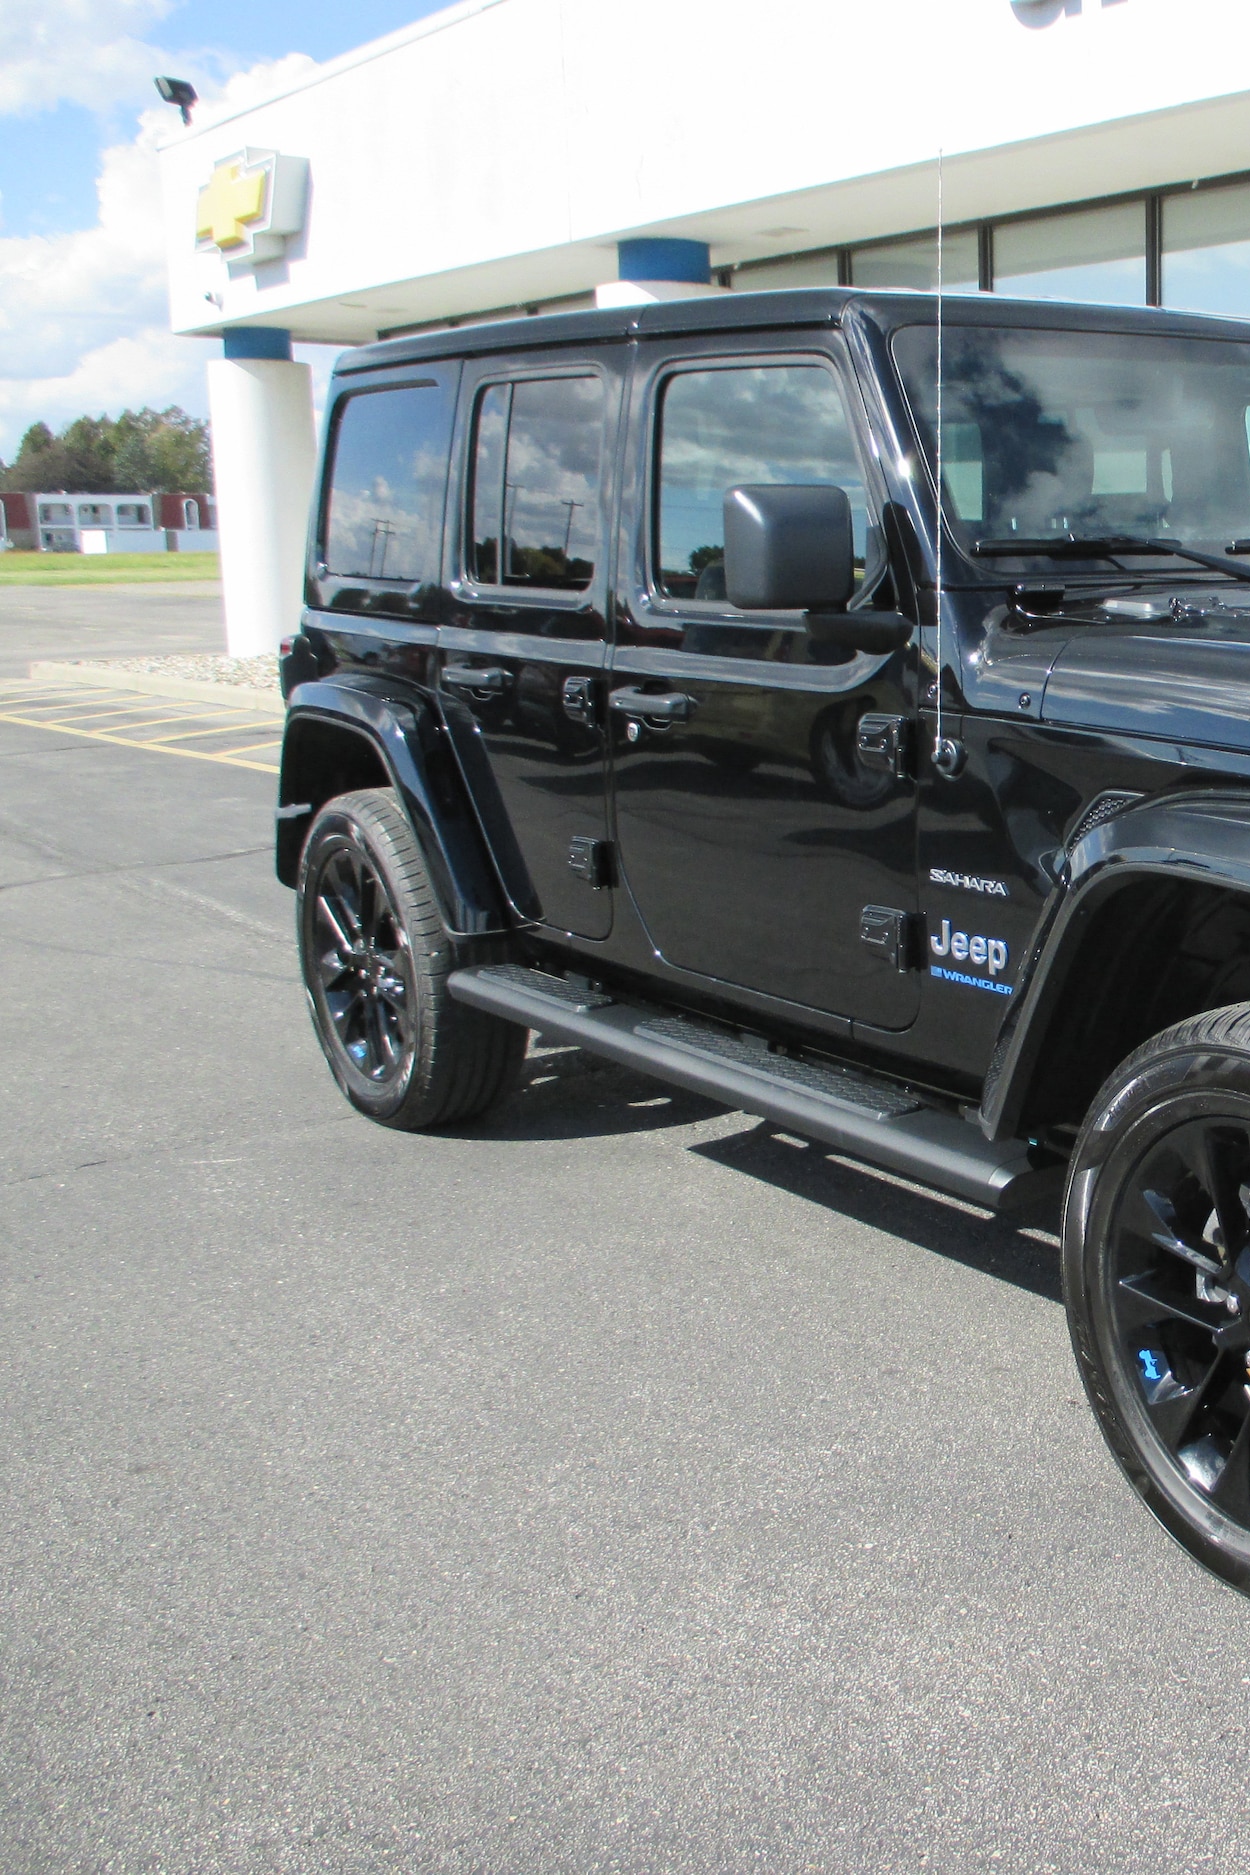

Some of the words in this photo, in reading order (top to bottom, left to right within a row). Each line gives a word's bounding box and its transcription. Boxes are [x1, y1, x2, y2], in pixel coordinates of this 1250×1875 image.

[929, 868, 1008, 896] SAHARA
[930, 919, 1008, 976] Jeep
[942, 968, 1014, 995] WRANGLER
